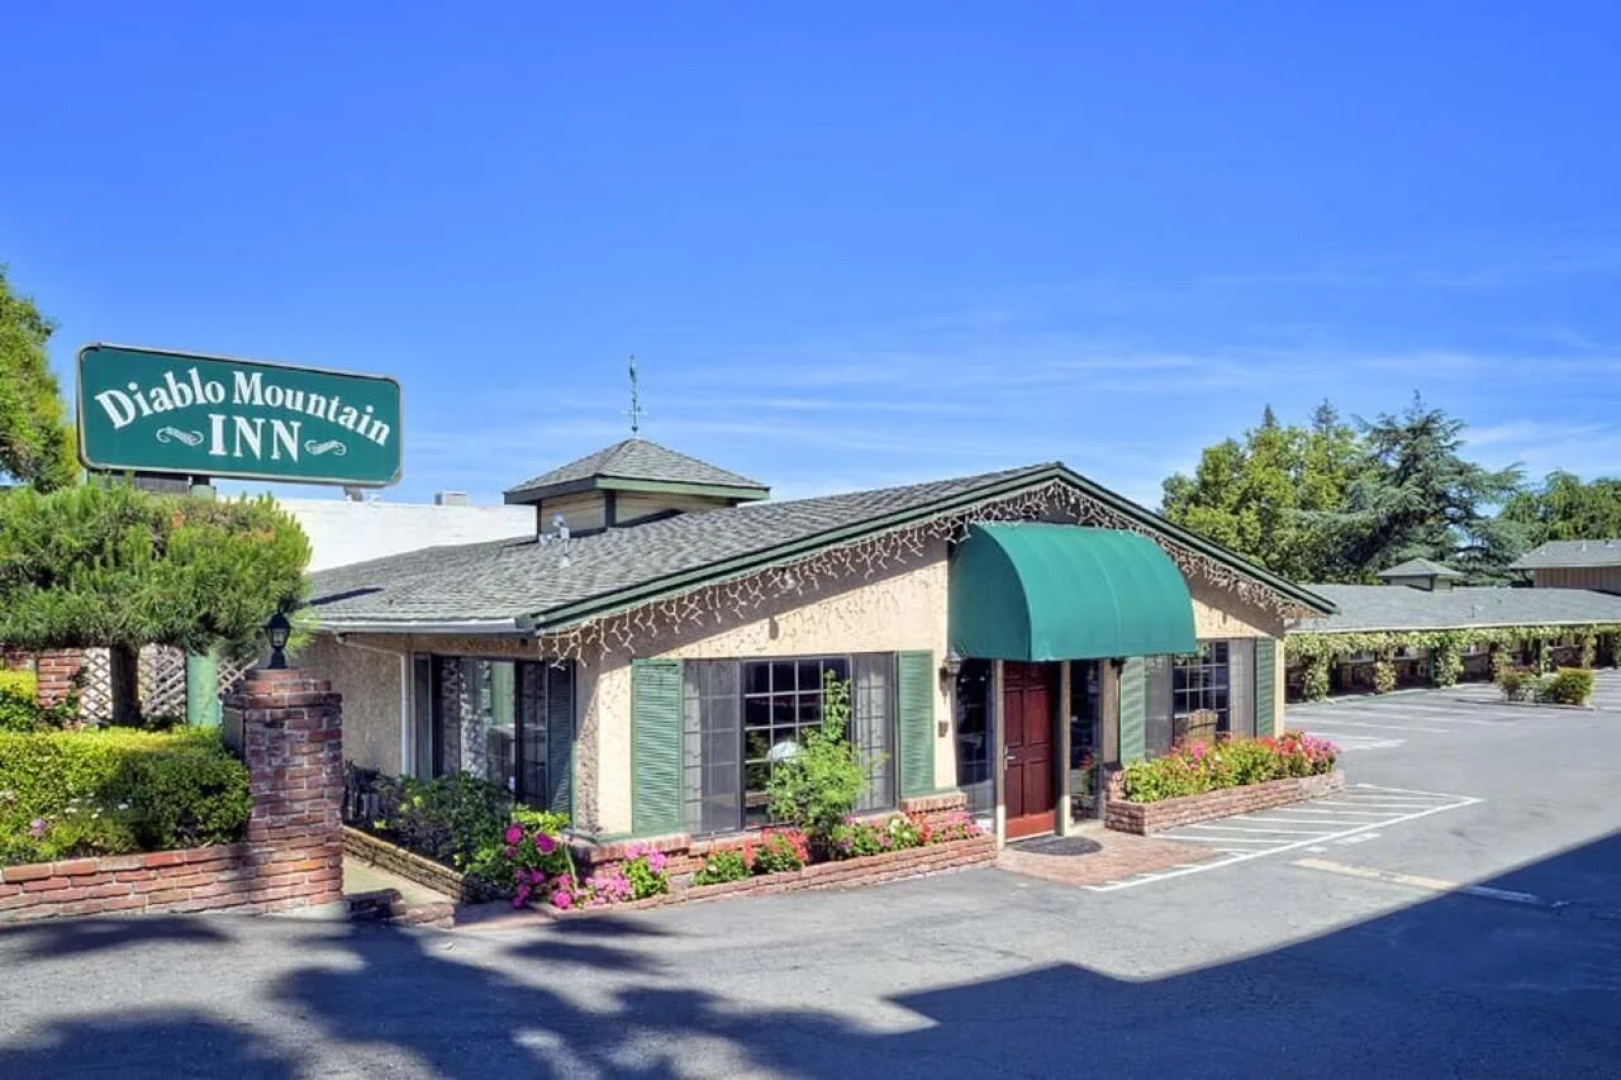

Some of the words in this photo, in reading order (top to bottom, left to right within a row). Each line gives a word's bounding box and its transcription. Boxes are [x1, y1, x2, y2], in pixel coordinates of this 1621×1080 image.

[95, 367, 225, 429] Diablo
[232, 371, 390, 446] Mountain
[208, 413, 302, 462] INN
